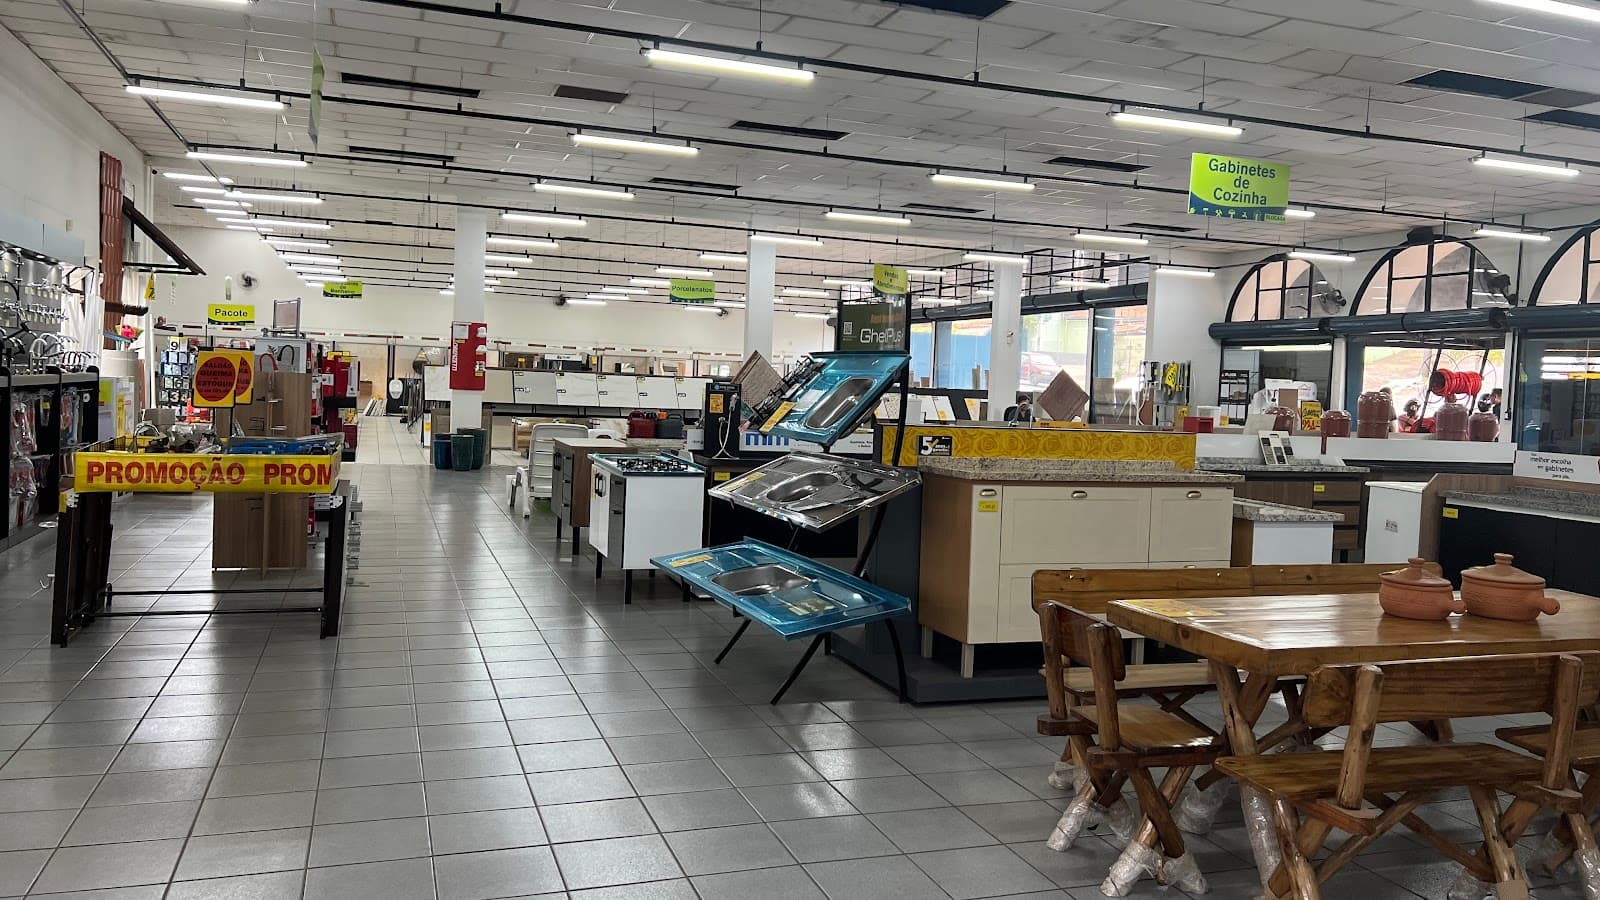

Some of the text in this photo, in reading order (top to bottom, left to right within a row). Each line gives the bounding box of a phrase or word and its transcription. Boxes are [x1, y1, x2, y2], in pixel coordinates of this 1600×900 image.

[1208, 158, 1277, 179] Gabinetes
[1233, 176, 1250, 189] de
[1213, 187, 1267, 205] Cozinha
[671, 285, 713, 293] Porcelanatos
[214, 308, 248, 317] Pacote
[170, 341, 179, 351] 9
[920, 436, 933, 456] 5
[86, 457, 246, 490] PROMOÇÃO
